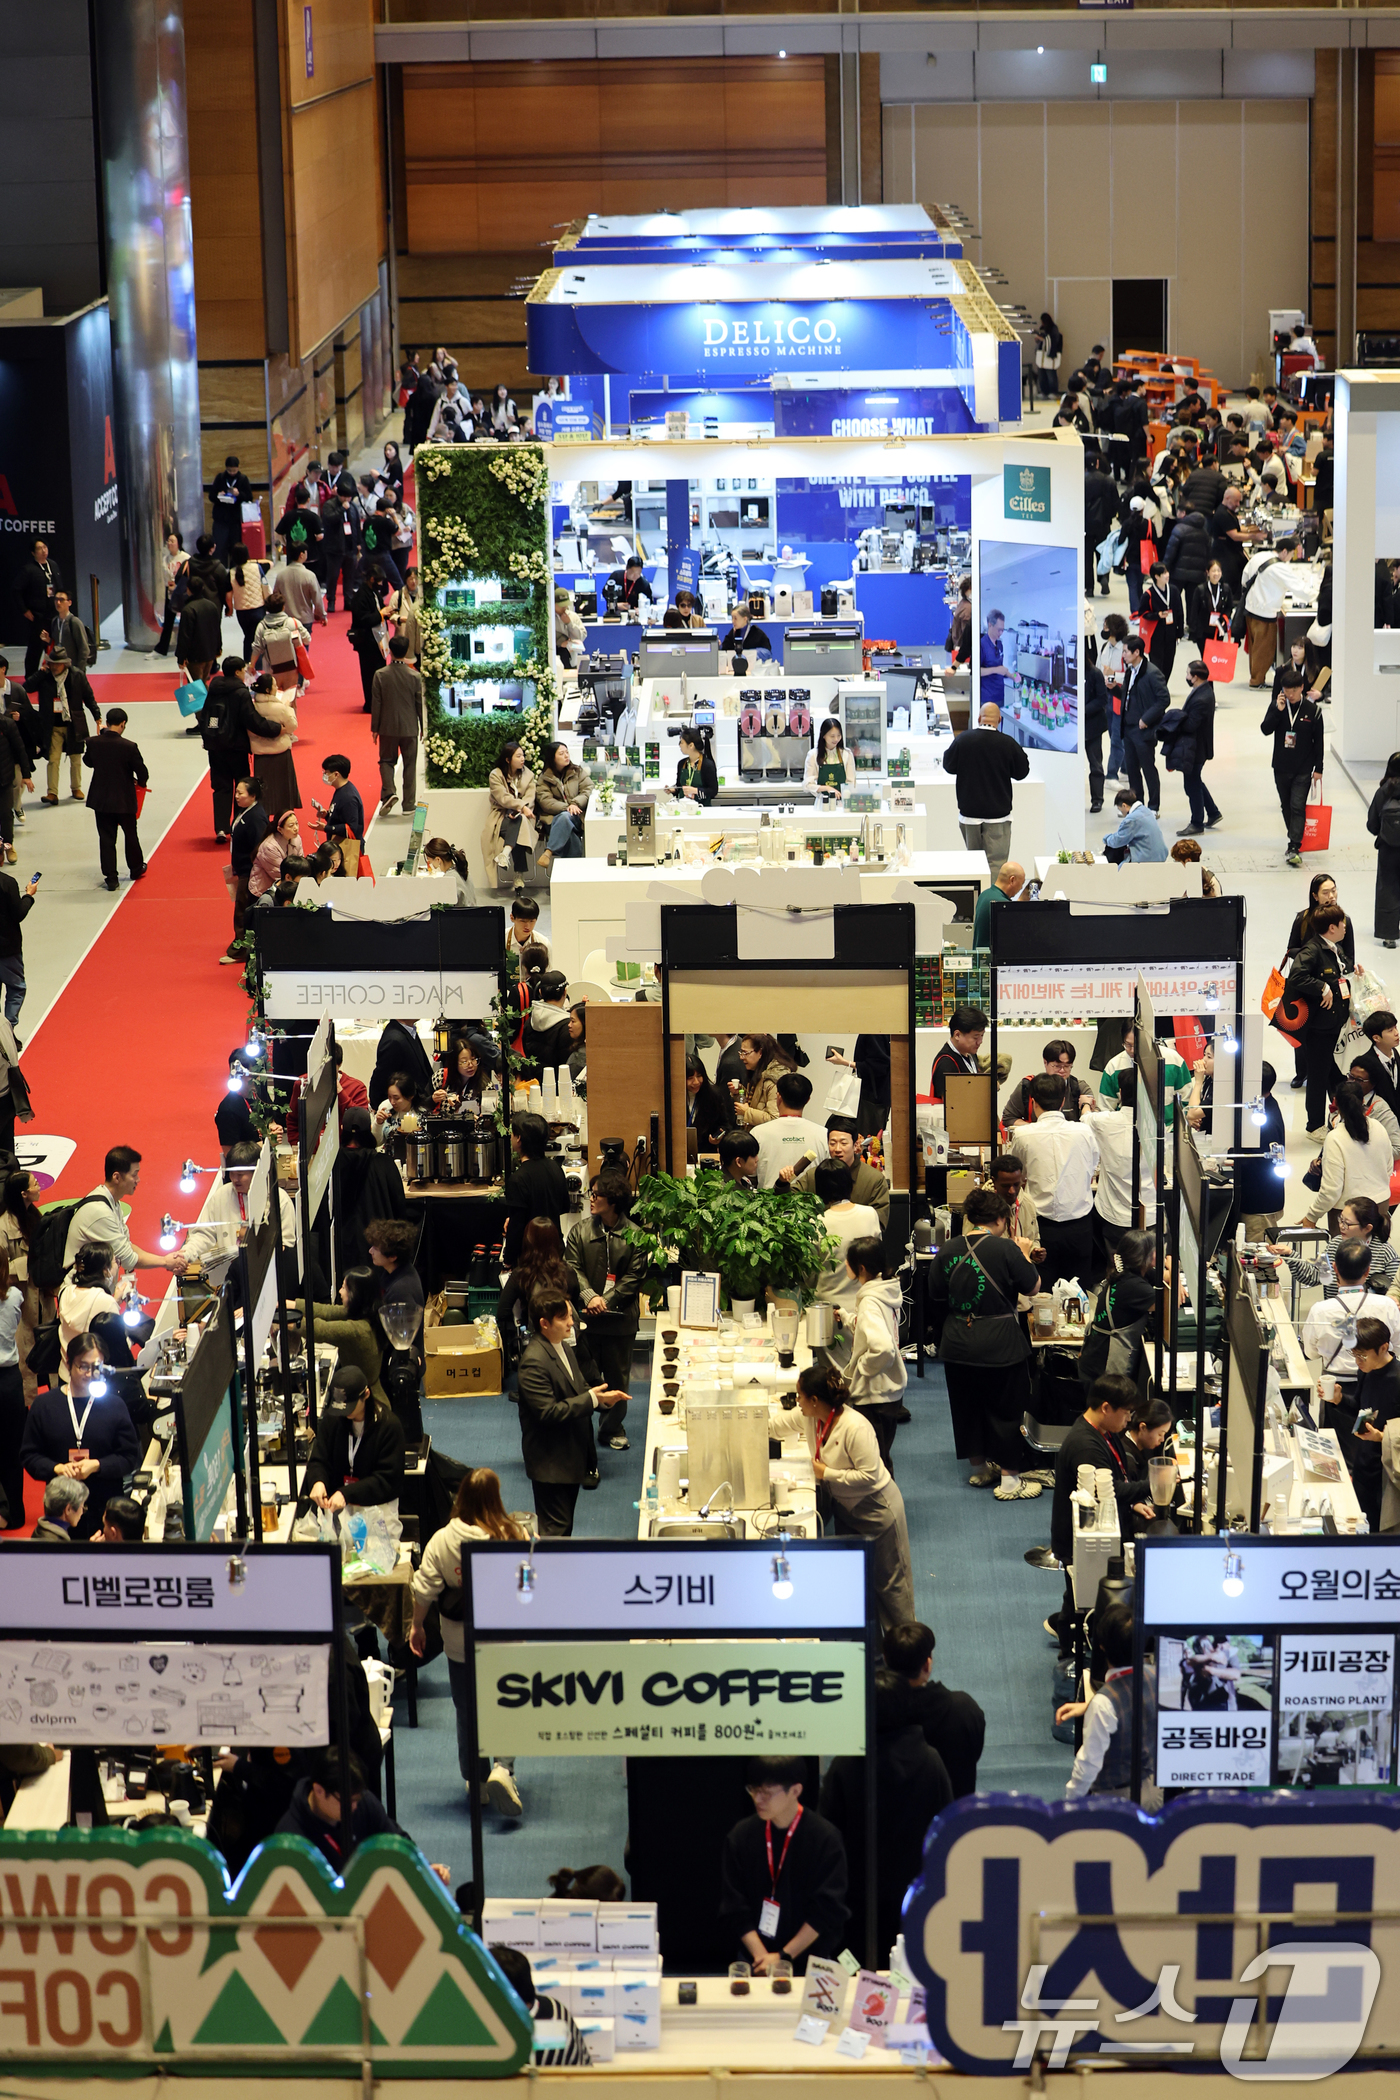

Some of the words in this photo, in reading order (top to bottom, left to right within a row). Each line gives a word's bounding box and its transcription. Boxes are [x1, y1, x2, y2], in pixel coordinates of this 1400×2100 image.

[704, 346, 770, 357] ESPRESSO
[777, 345, 841, 356] MACHINE
[832, 418, 888, 437] CHOOSE
[891, 417, 934, 436] WHAT
[838, 487, 876, 508] WITH
[1009, 495, 1045, 513] Eilles
[4, 519, 56, 533] COFFEE
[62, 1575, 215, 1608] 디벨로핑룸
[623, 1574, 715, 1606] 스키비
[1279, 1568, 1400, 1601] 오월의숲
[1284, 1650, 1391, 1673] 커피공장
[496, 1670, 624, 1708] SKIVI
[641, 1669, 845, 1707] COFFEE
[1284, 1696, 1346, 1705] ROASTING
[1348, 1695, 1387, 1705] PLANT
[612, 1724, 663, 1741] 스페셜티
[671, 1722, 706, 1741] 커피를
[1161, 1726, 1267, 1750] 공동바잉
[1170, 1772, 1214, 1781] DIRECT
[1216, 1771, 1256, 1781] TRADE
